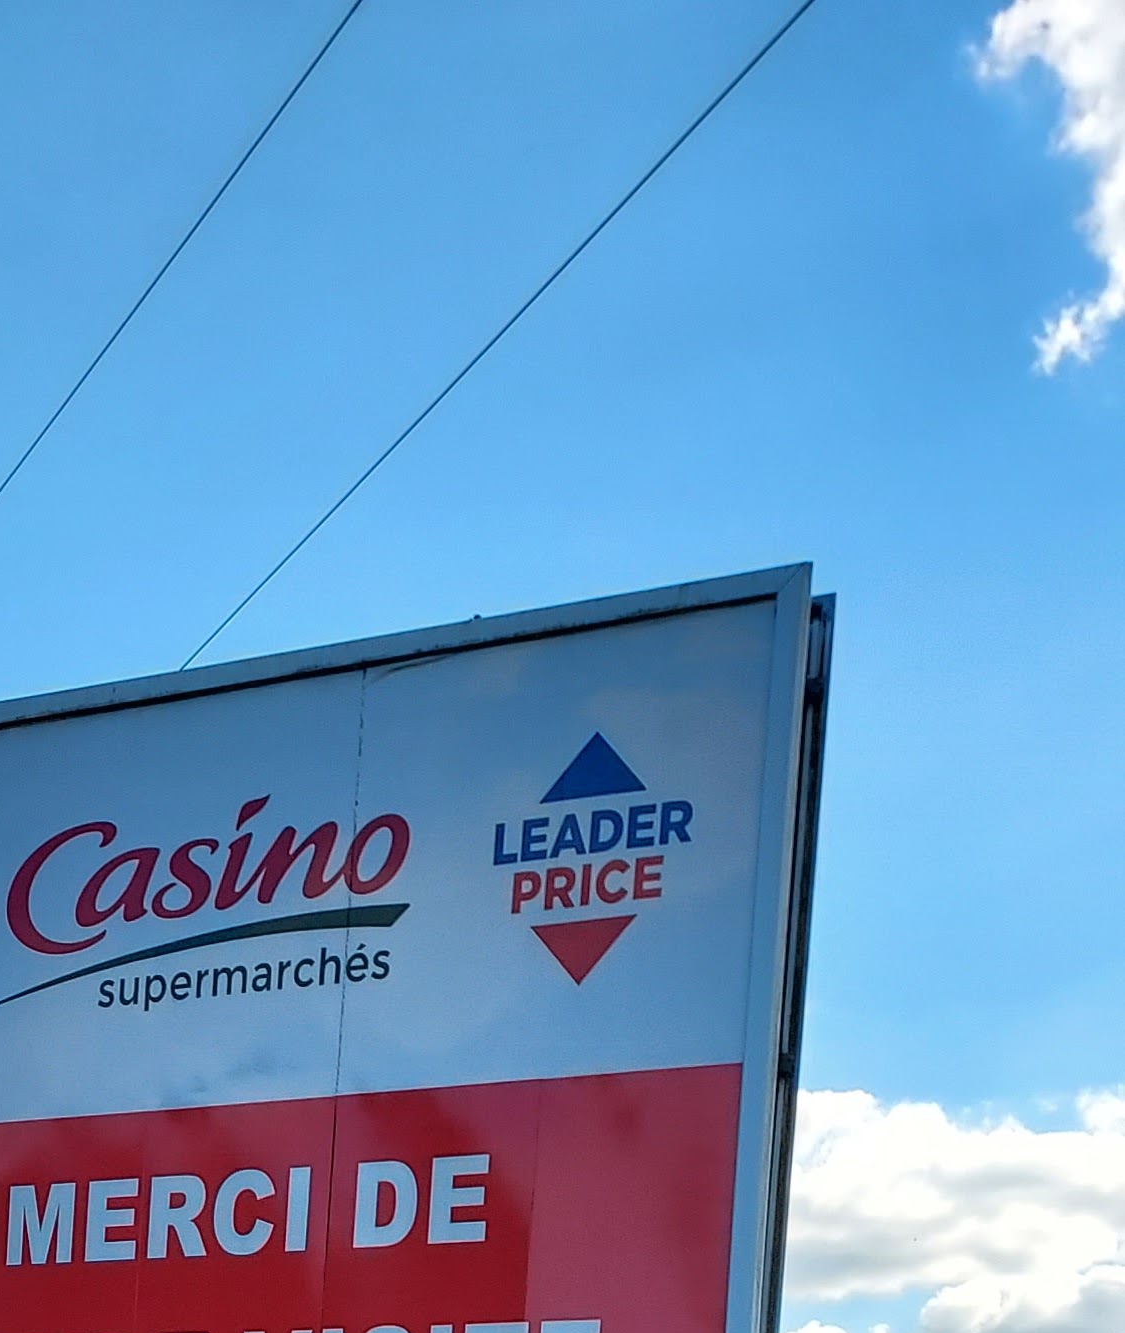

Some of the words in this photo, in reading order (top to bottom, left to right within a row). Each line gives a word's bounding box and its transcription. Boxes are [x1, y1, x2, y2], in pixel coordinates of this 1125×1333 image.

[493, 800, 694, 866] LEADER
[7, 794, 411, 955] Casino
[511, 855, 665, 915] PRICE
[98, 944, 391, 1011] supermarchés
[5, 1166, 313, 1266] MERCI
[352, 1153, 491, 1249] DE
